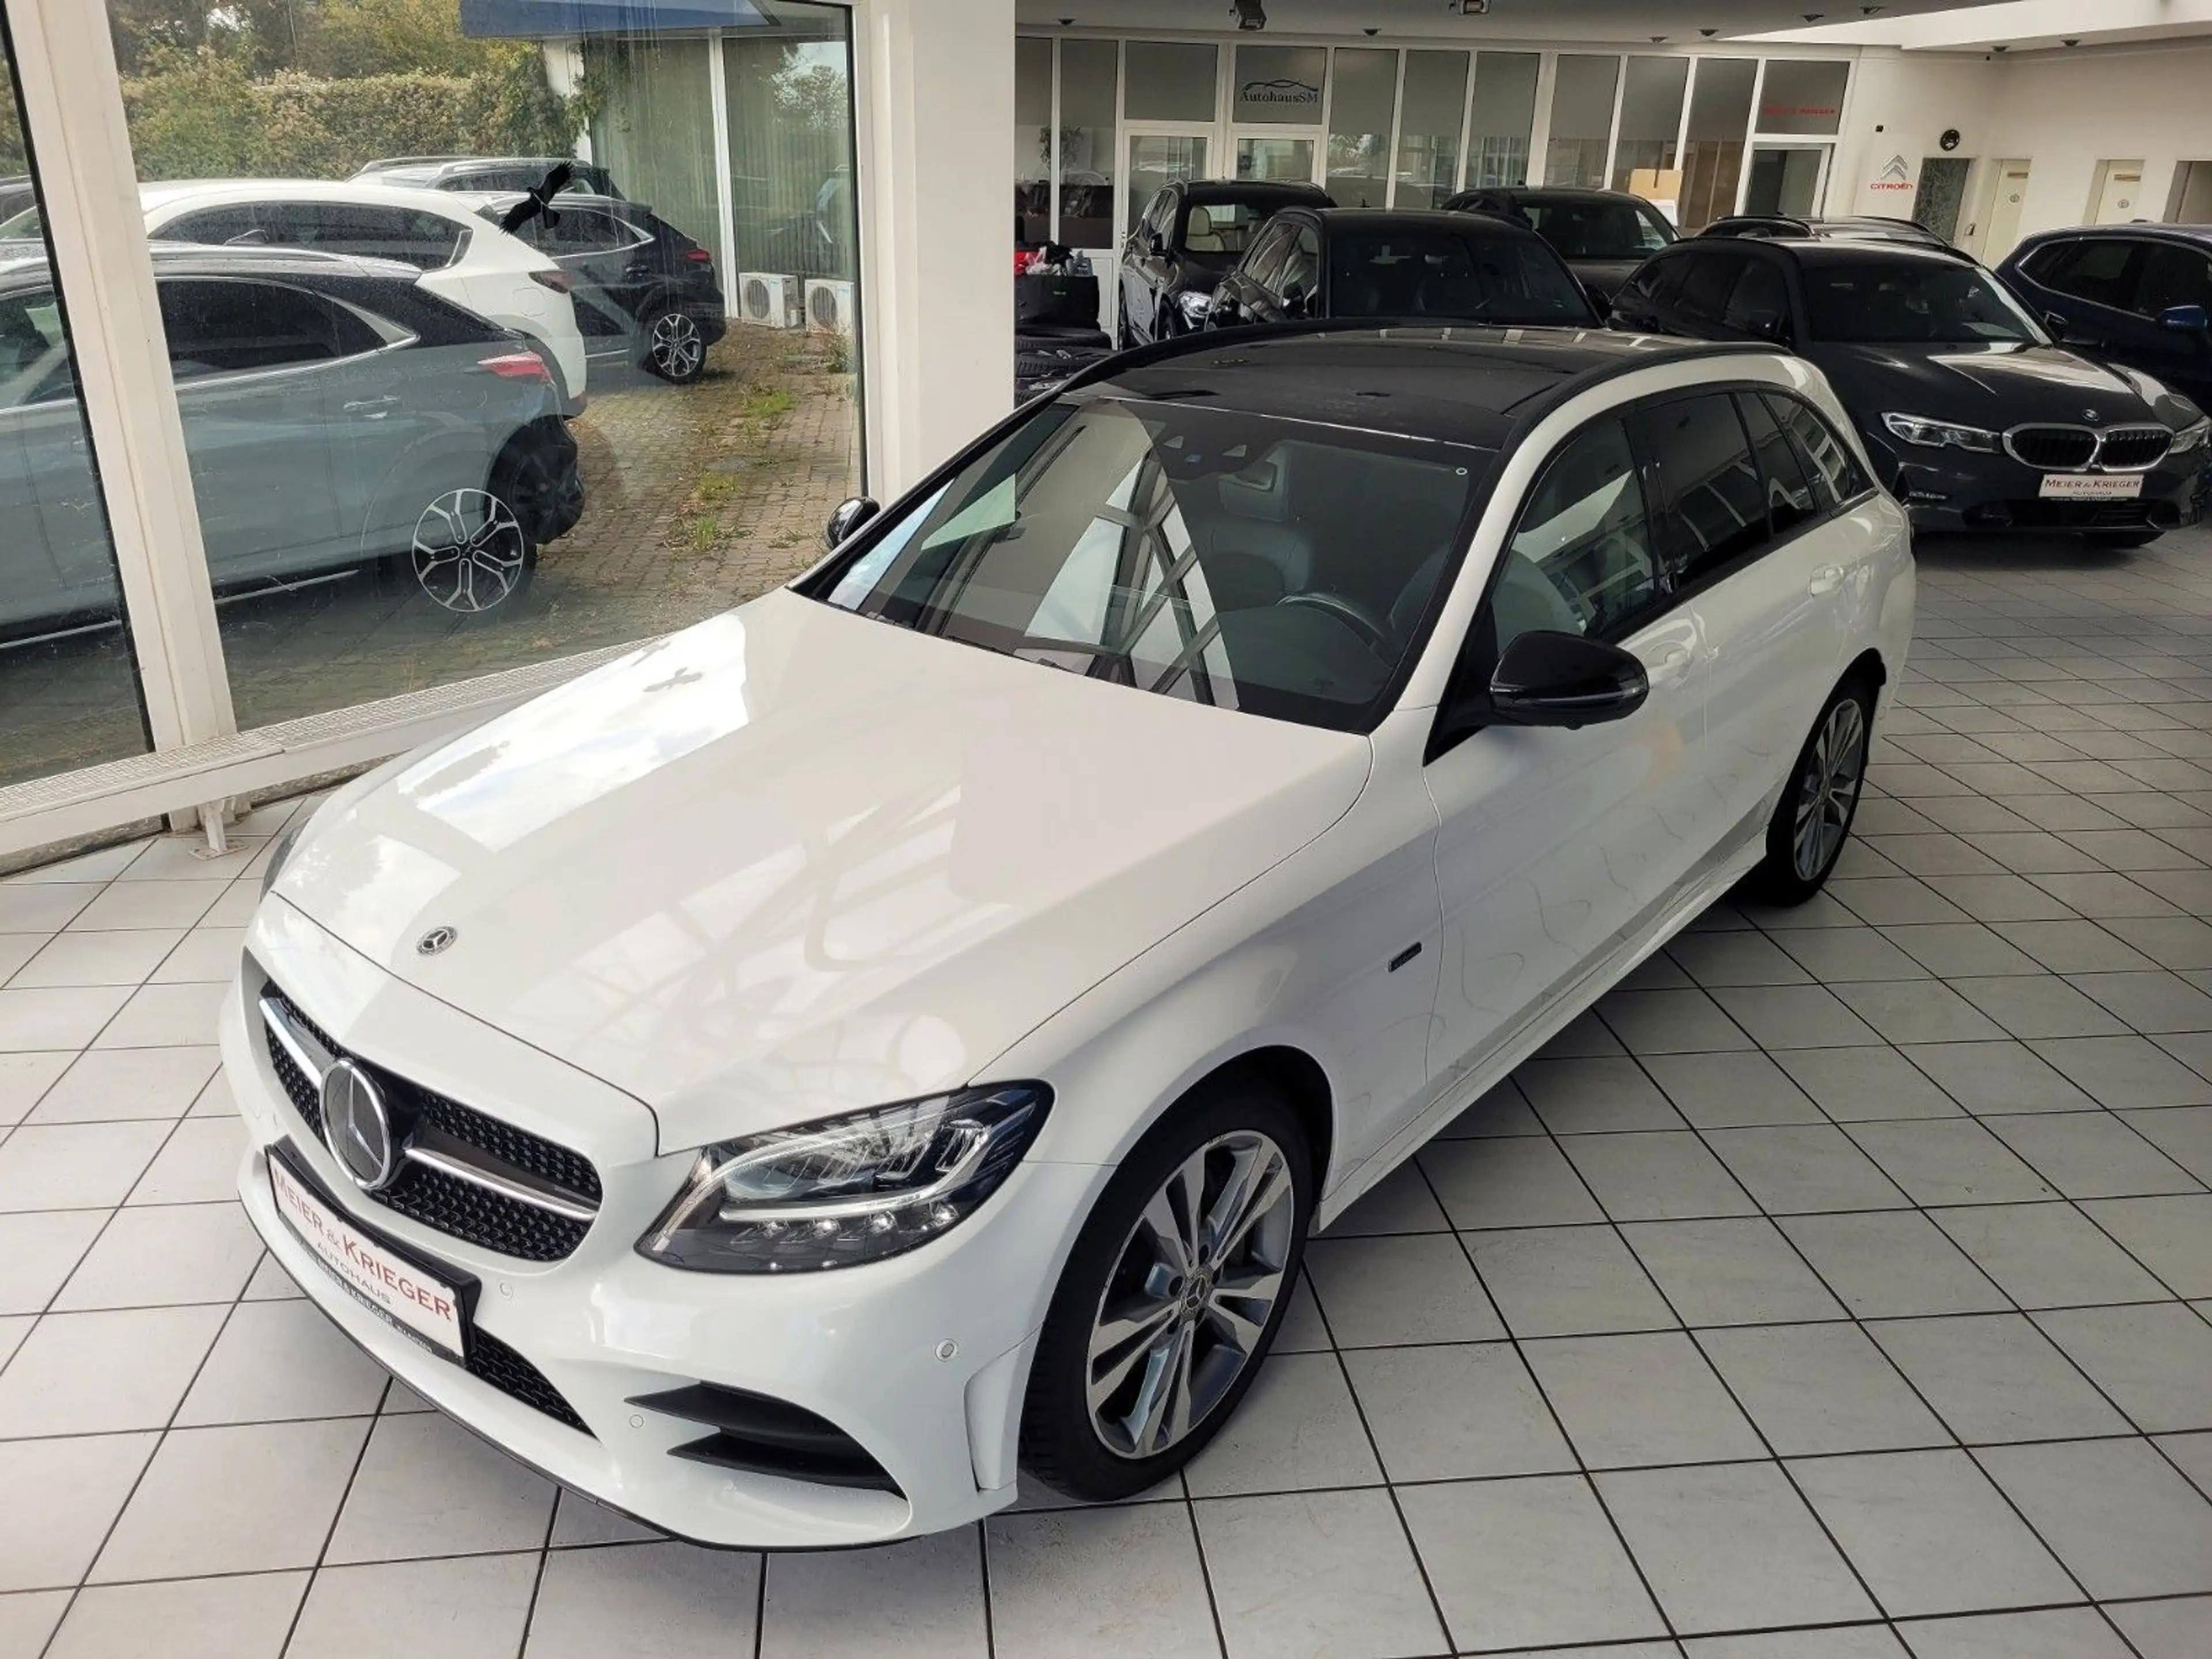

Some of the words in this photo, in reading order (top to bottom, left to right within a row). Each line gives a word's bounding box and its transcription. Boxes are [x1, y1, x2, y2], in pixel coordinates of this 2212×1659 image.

[1240, 92, 1318, 103] AutohausSM
[2046, 479, 2082, 488] MEIER
[2092, 479, 2140, 488] KRIEGER
[273, 1167, 324, 1236] MEIER
[343, 1234, 452, 1323] KRIEGER
[317, 1242, 391, 1305] AUTOHAUS
